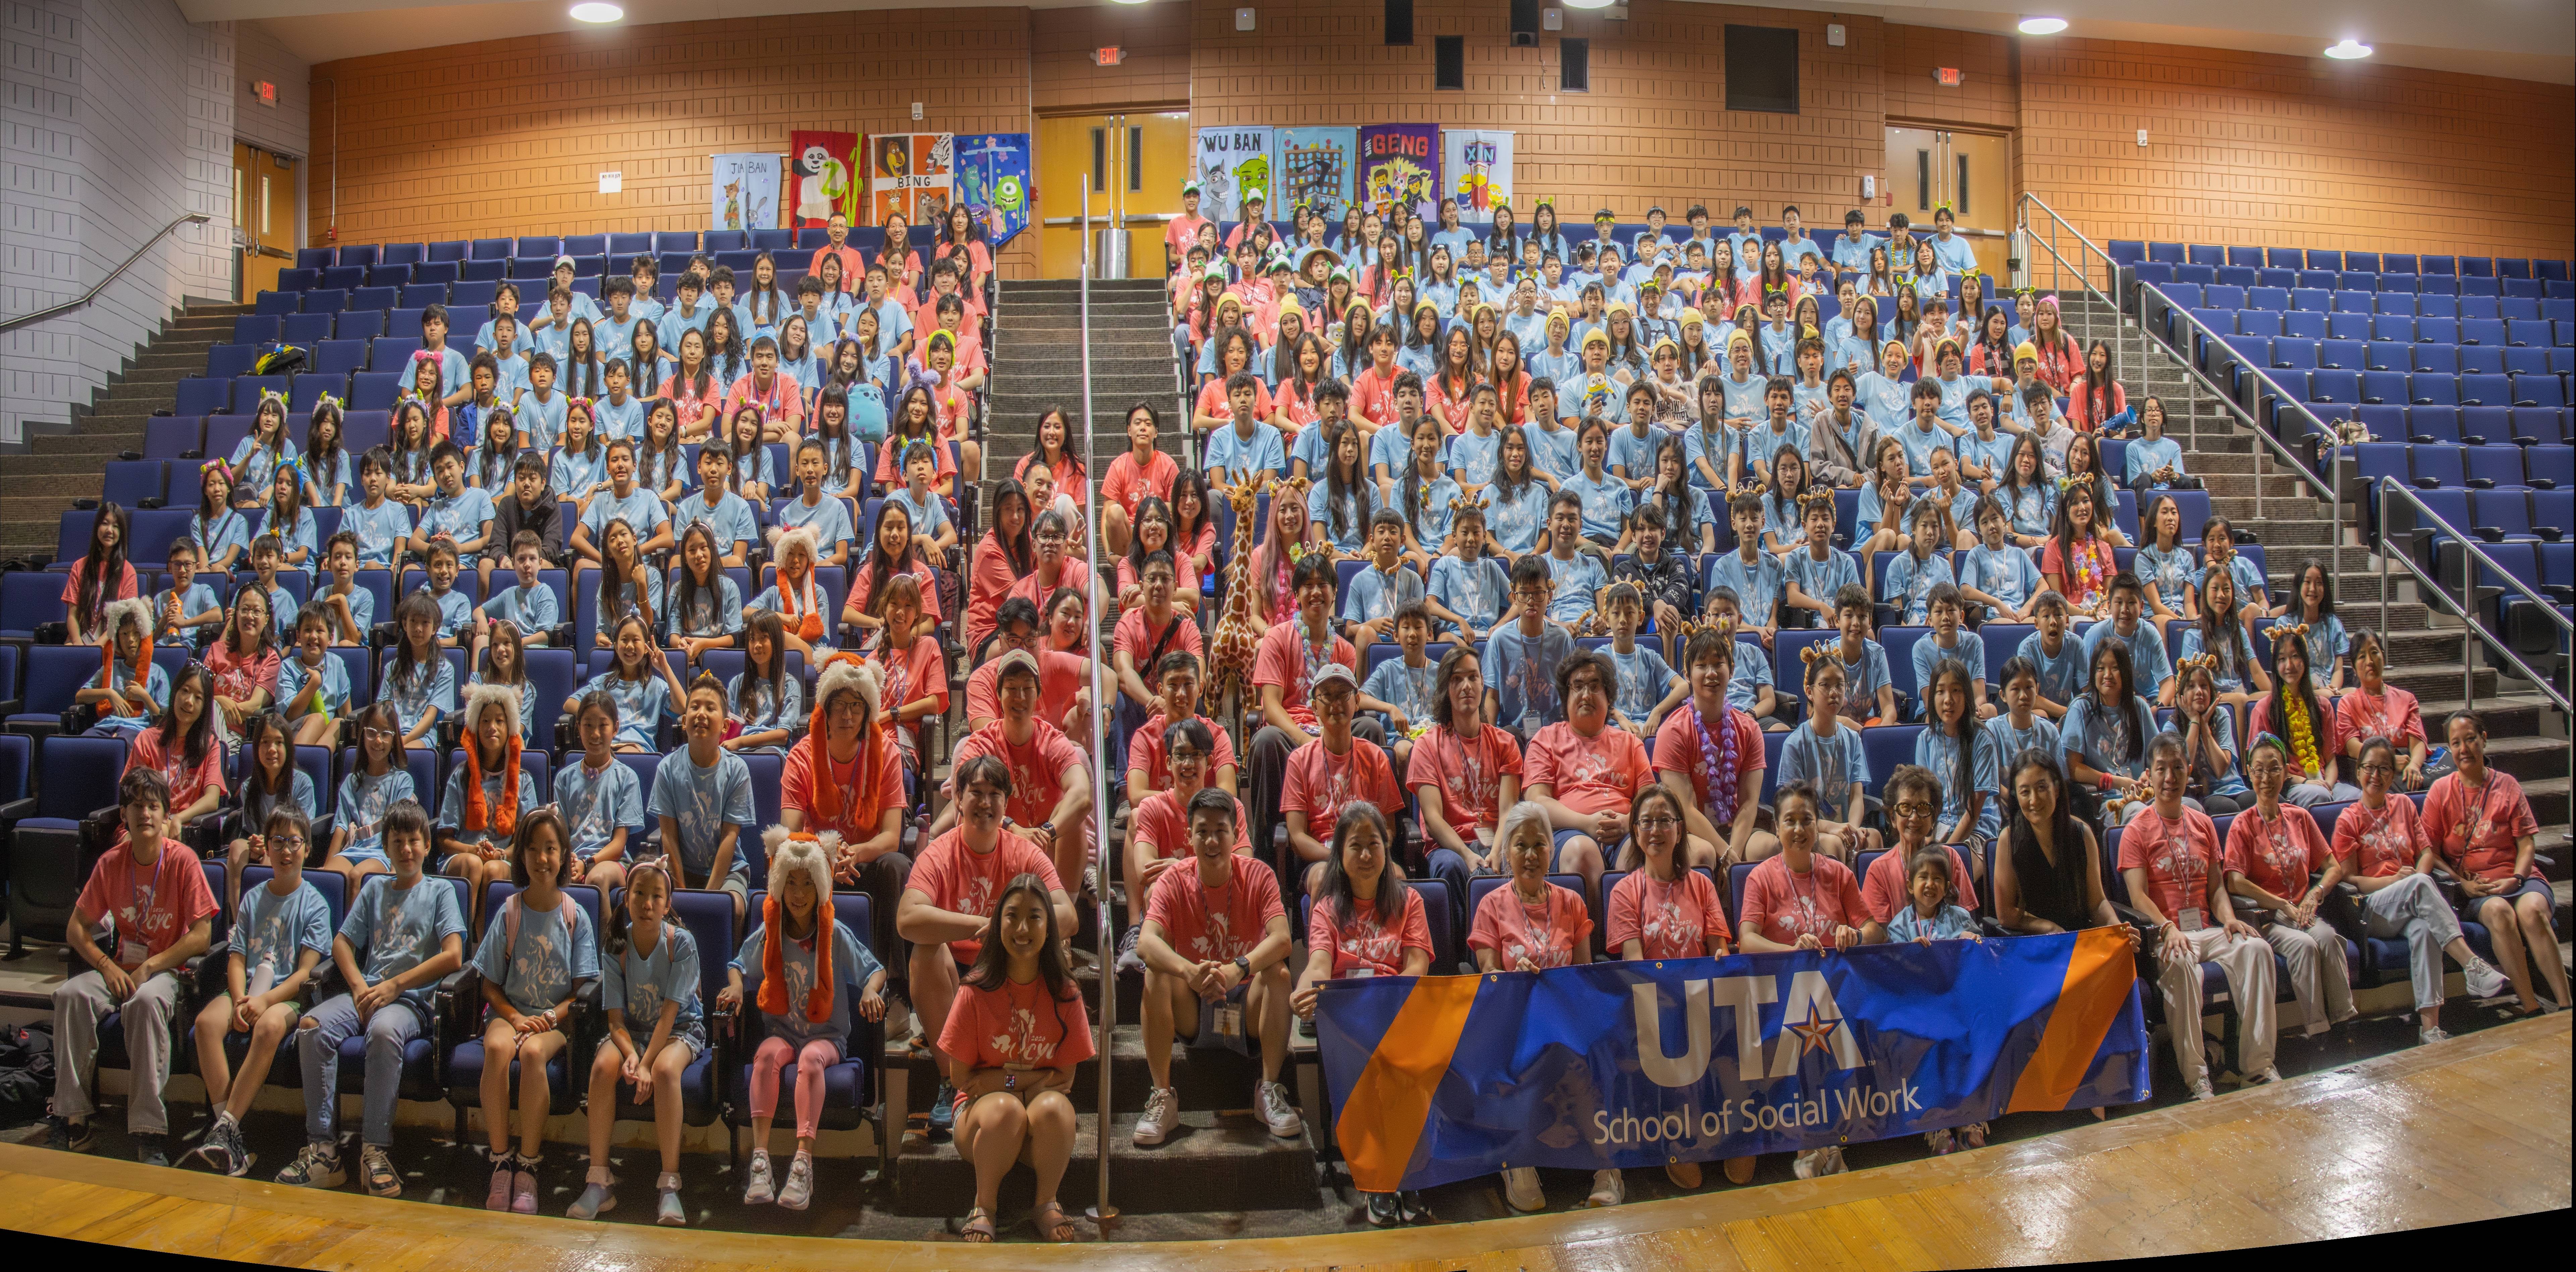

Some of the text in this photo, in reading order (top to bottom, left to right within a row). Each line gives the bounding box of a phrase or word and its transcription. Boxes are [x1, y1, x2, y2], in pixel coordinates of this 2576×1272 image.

[1100, 48, 1118, 64] EXIT
[1942, 68, 1957, 84] EXIT
[263, 82, 274, 100] EXIT
[1204, 133, 1261, 152] WU BAN
[1373, 133, 1429, 157] GENG
[1466, 146, 1495, 162] XIN
[731, 163, 767, 174] JIA BAN
[898, 175, 931, 188] BING
[1024, 787, 1047, 808] CYC
[146, 913, 172, 933] CYC
[1673, 924, 1702, 950] CYC
[1370, 939, 1402, 962] CYC
[1632, 970, 1866, 1087] UTA
[1023, 1043, 1058, 1064] CYC
[1594, 1078, 1922, 1145] School of Social Work
